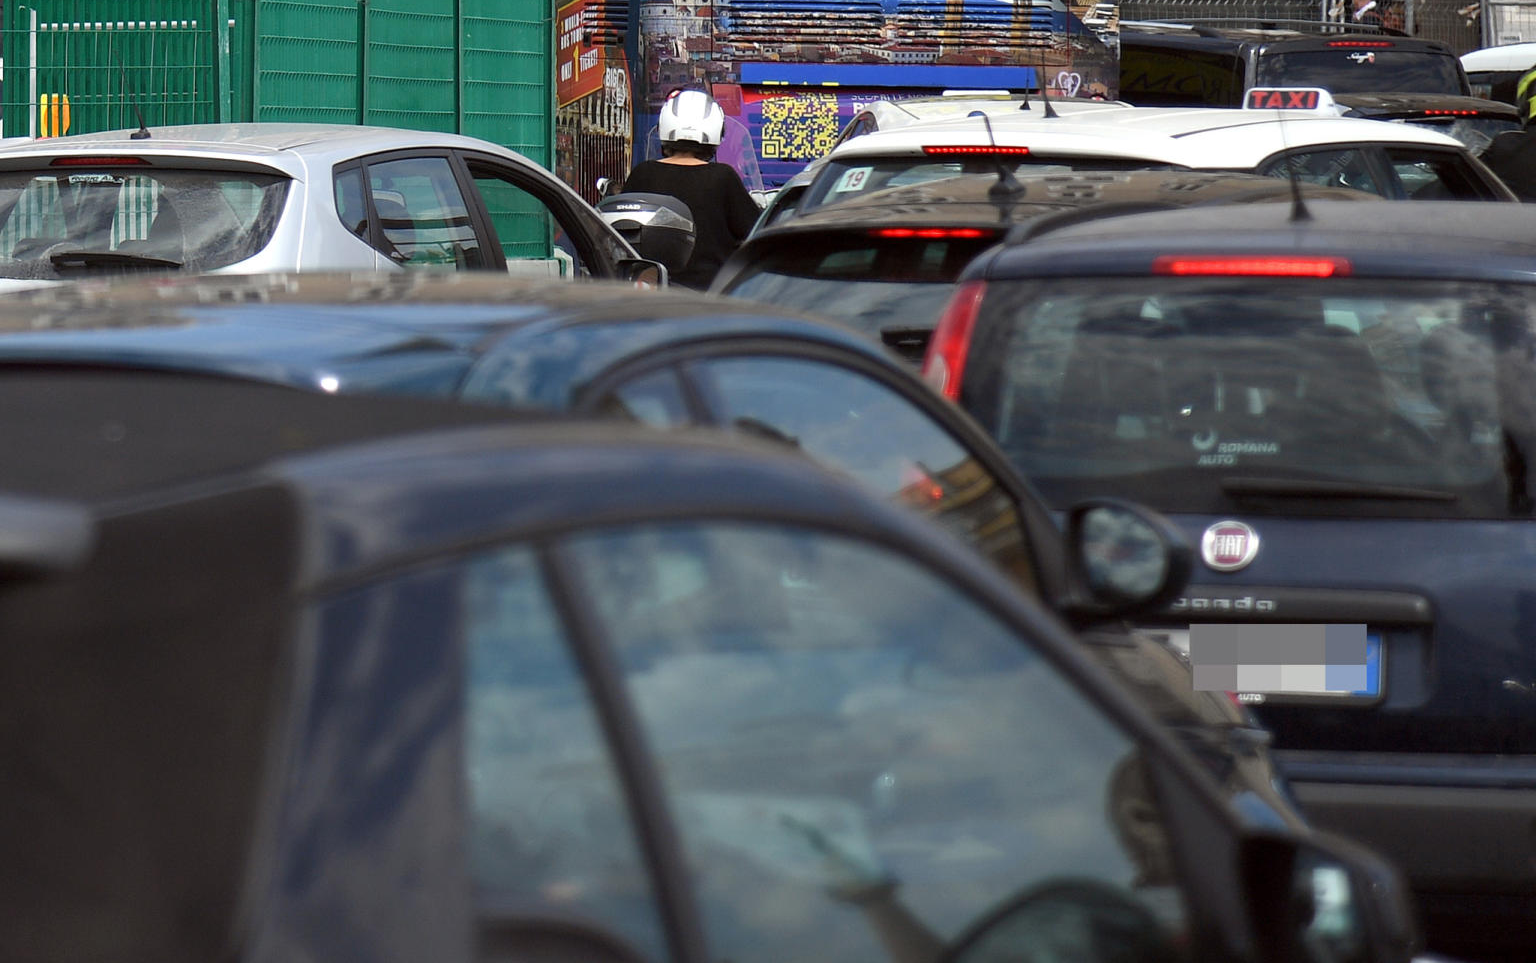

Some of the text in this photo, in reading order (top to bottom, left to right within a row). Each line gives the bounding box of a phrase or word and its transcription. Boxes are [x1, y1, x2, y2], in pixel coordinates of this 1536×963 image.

[605, 67, 617, 88] BIG
[1251, 91, 1318, 109] TAXI
[847, 171, 865, 187] 19
[1218, 442, 1278, 453] ROMANA
[1198, 454, 1234, 465] AUTO
[1213, 534, 1245, 556] FIAT
